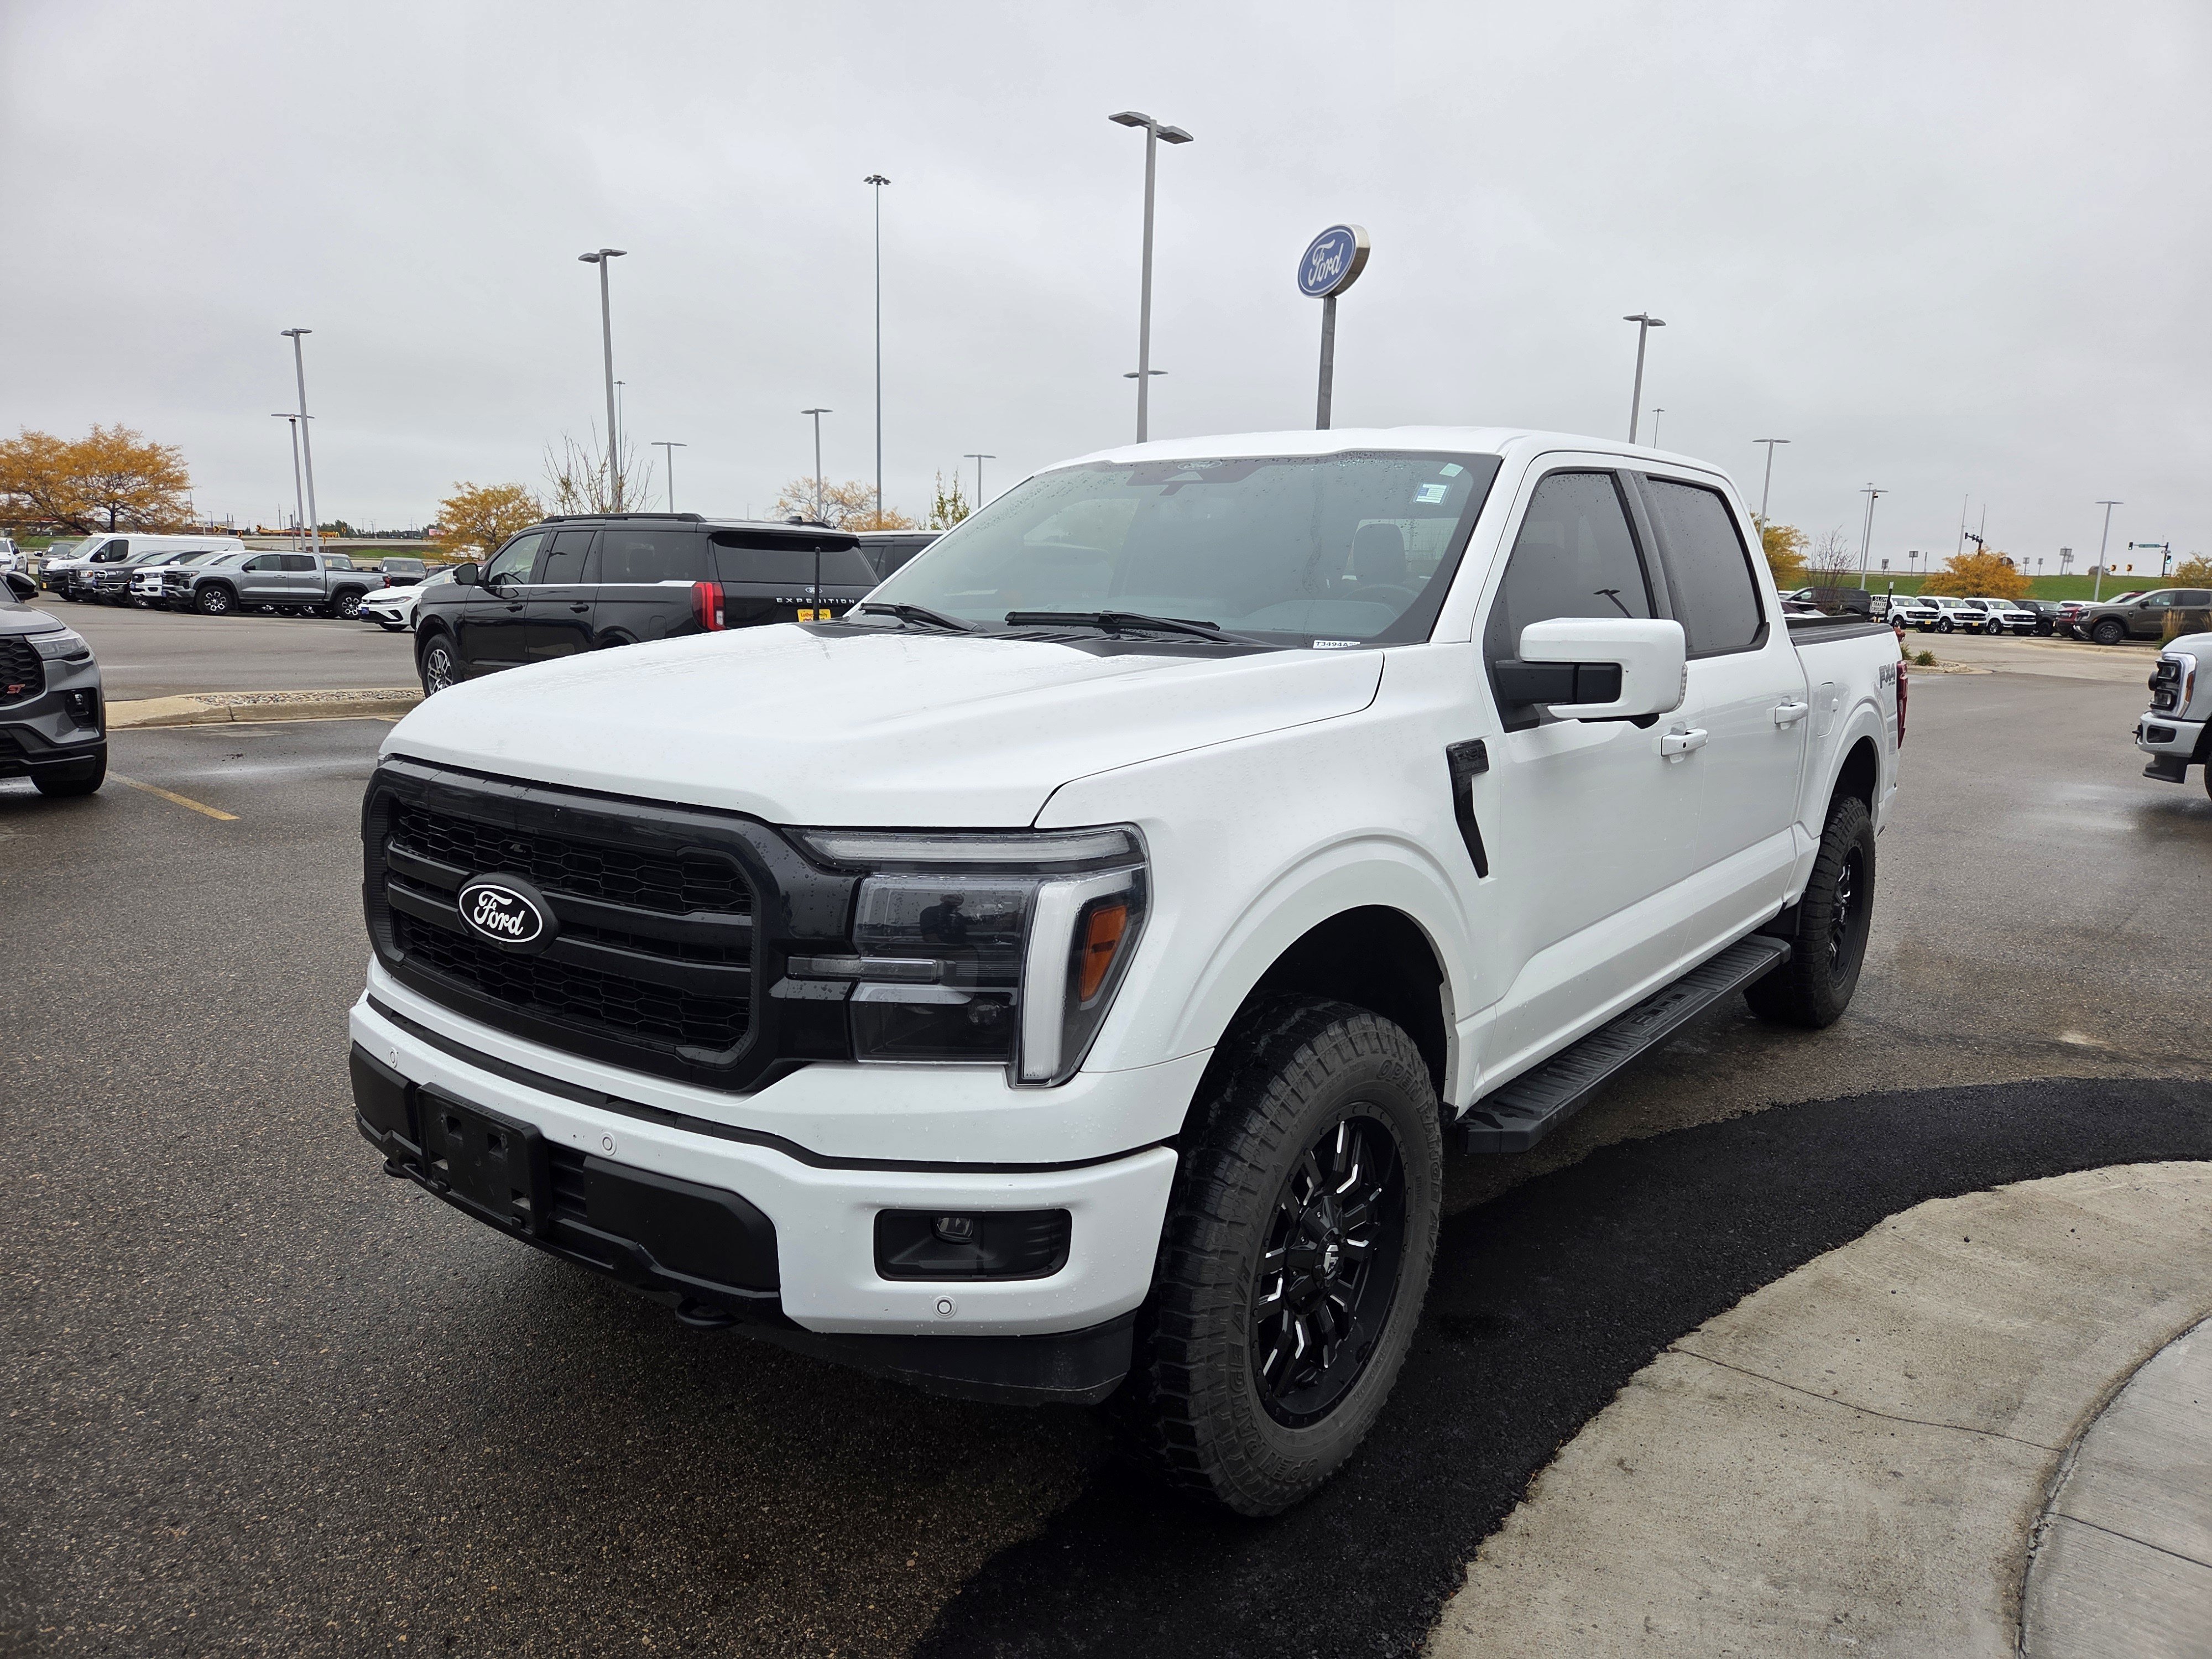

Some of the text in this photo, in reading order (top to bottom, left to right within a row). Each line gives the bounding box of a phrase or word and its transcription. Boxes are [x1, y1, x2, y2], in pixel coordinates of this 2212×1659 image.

[1308, 239, 1344, 286] Ford
[7, 684, 25, 694] ST
[1879, 662, 1896, 689] FX4
[474, 891, 525, 936] Ford
[1376, 1059, 1424, 1102] OPEN
[1228, 1342, 1266, 1459] RANGE
